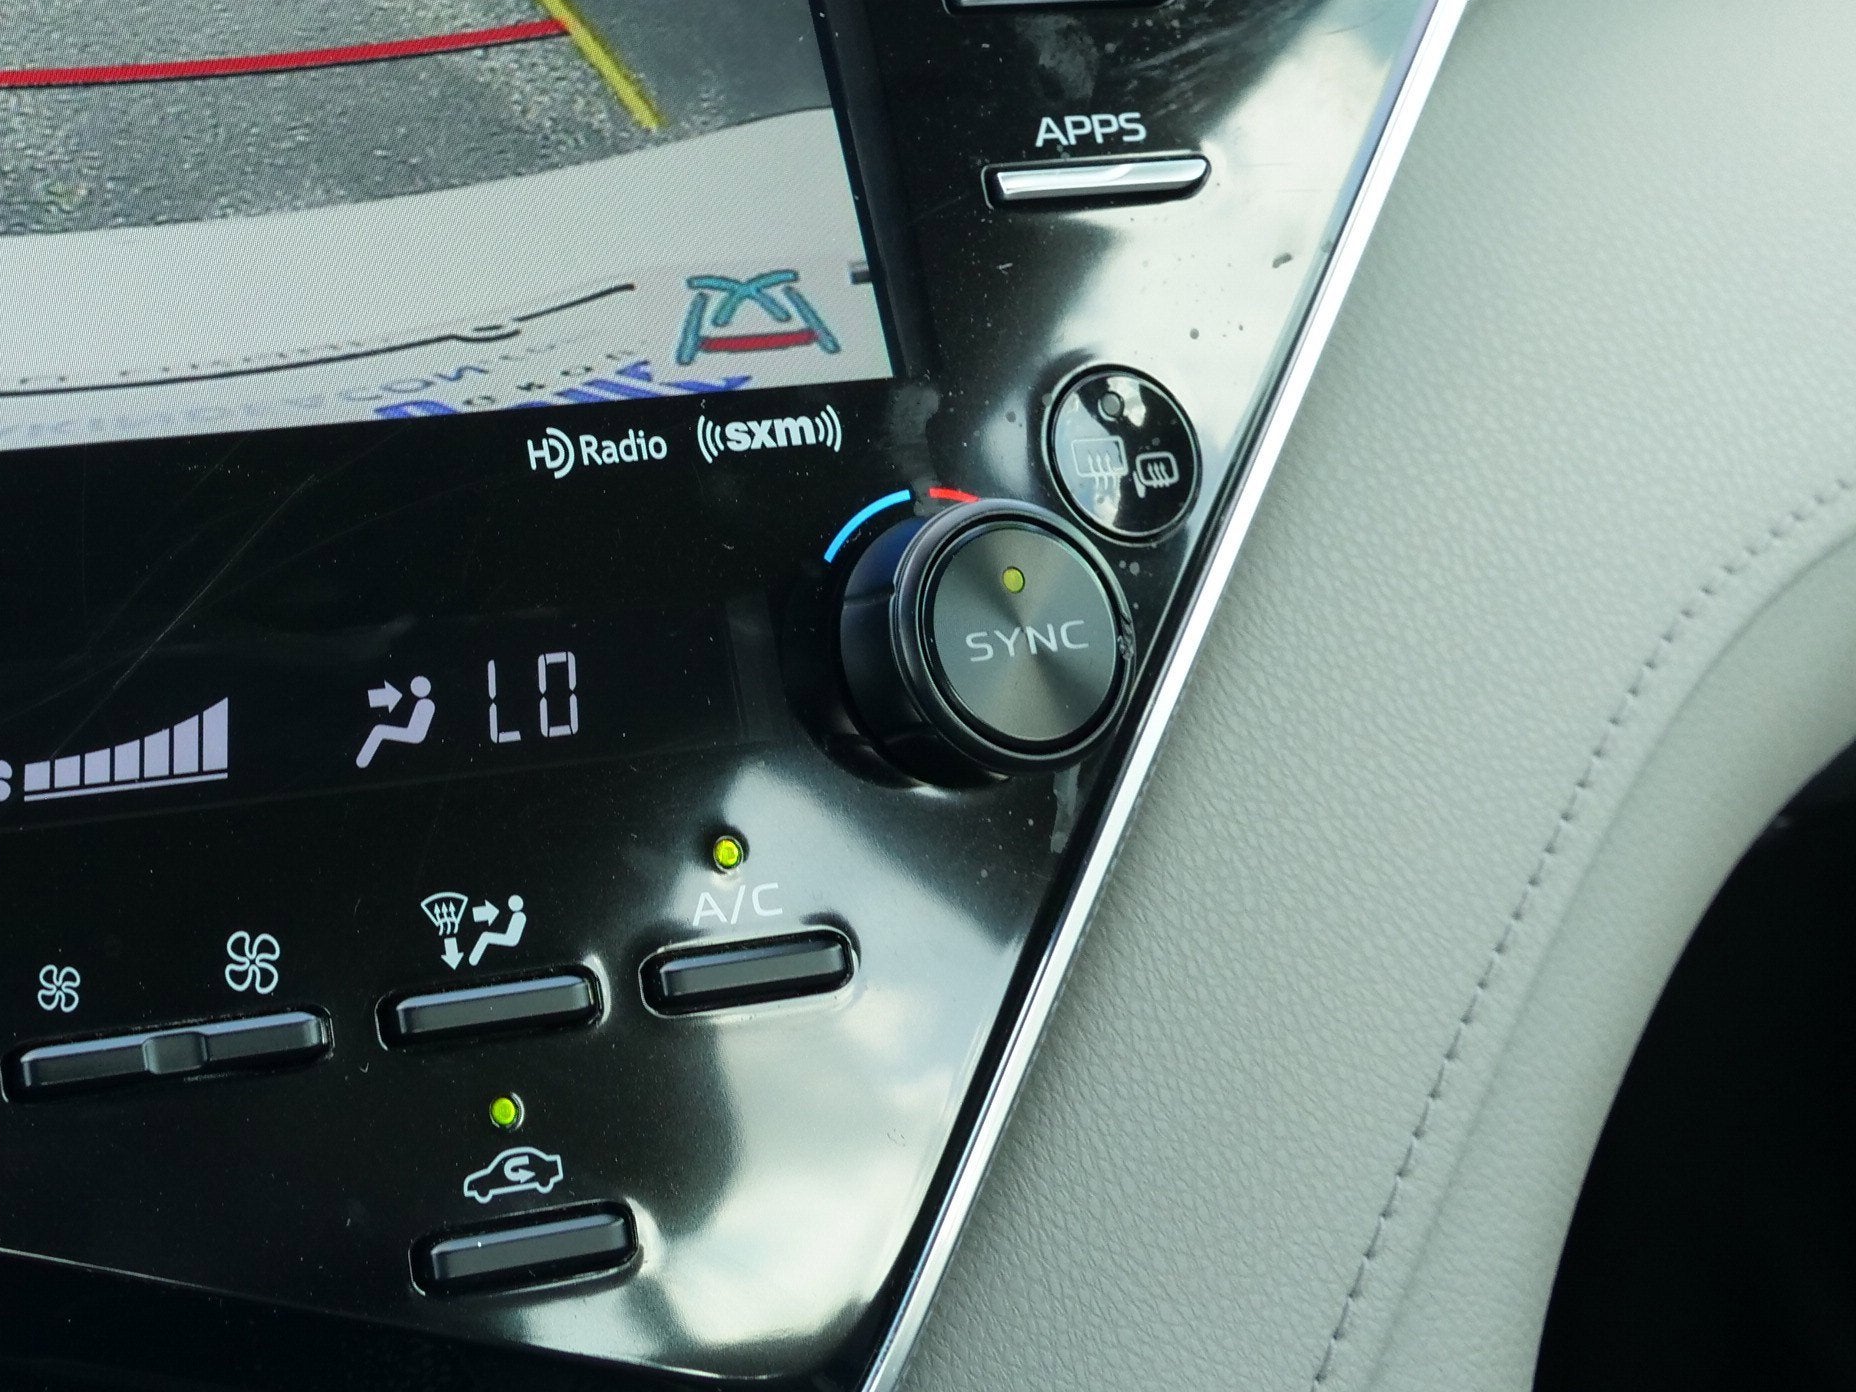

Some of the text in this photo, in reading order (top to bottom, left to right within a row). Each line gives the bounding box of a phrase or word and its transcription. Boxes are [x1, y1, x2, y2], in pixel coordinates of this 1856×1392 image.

[1035, 112, 1147, 148] APPS
[526, 426, 668, 479] HD Radio
[965, 620, 1089, 662] SYNC
[692, 882, 783, 927] A/C
